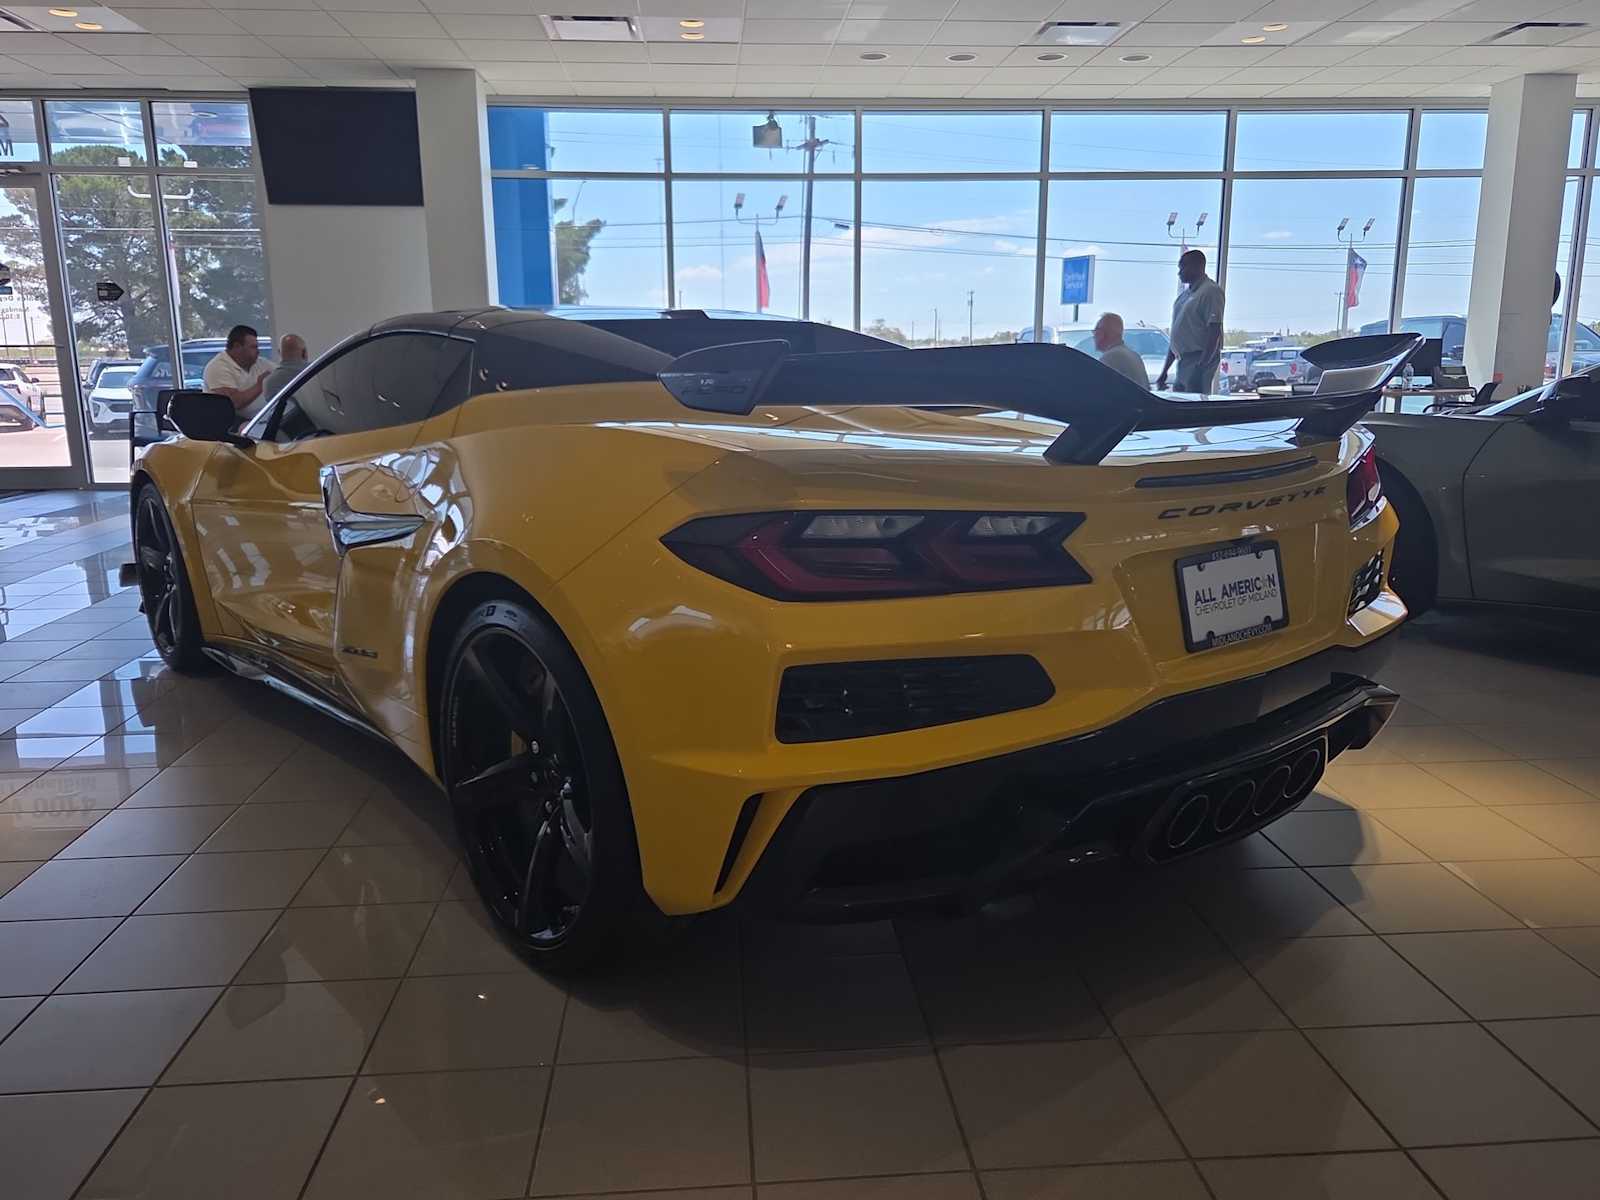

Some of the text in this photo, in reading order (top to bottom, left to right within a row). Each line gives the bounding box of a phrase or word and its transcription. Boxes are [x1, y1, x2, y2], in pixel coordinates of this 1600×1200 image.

[1157, 485, 1327, 520] CORVETTE
[1194, 587, 1216, 606] ALL
[1195, 588, 1278, 616] CHEVROLET OF MIDLAND
